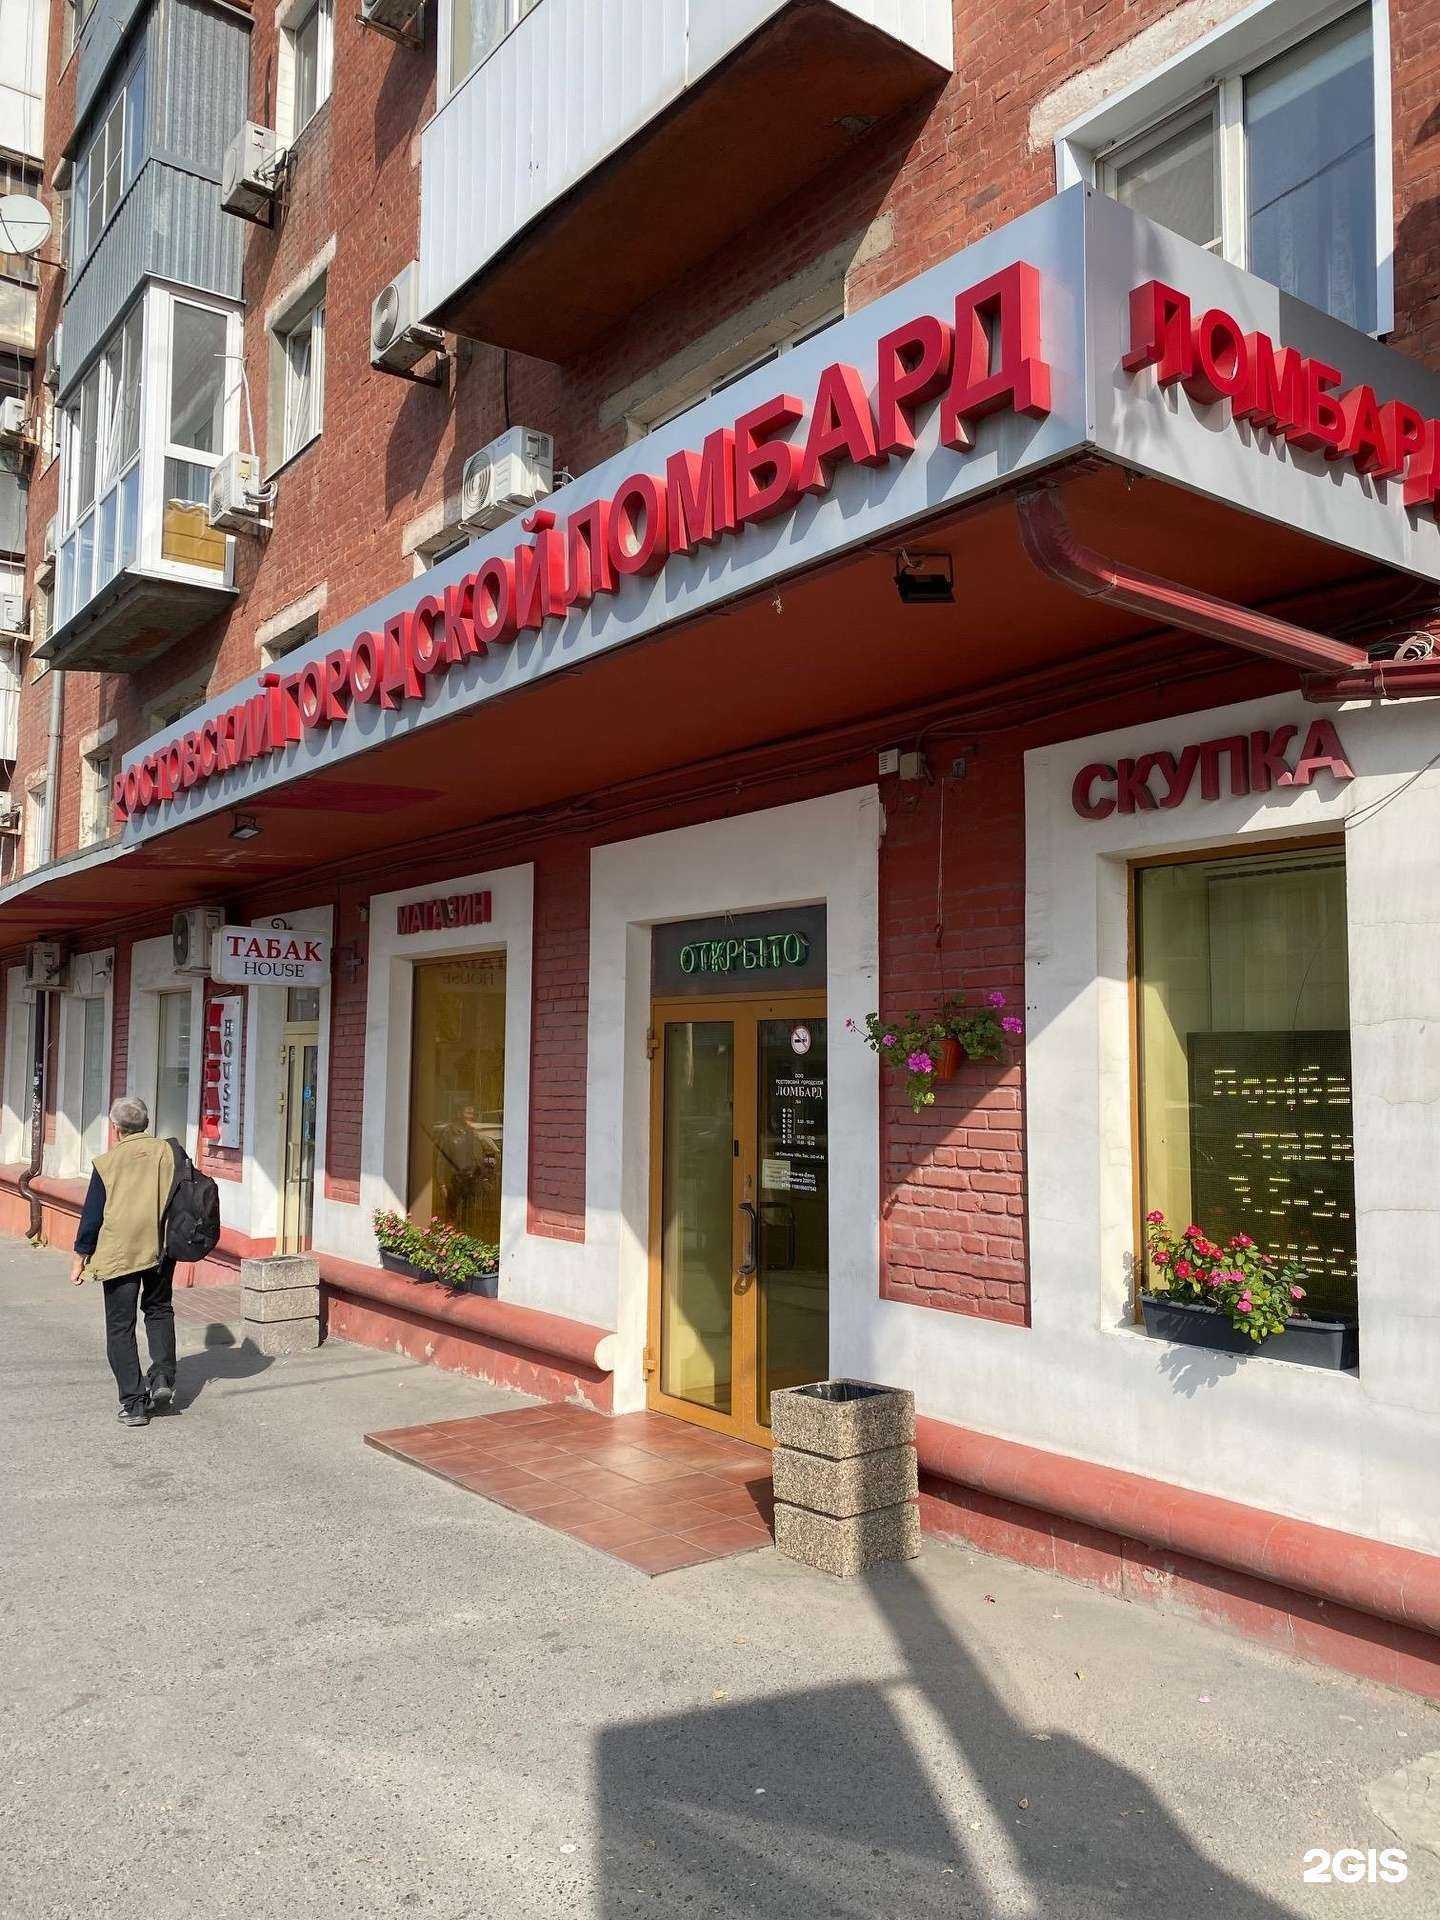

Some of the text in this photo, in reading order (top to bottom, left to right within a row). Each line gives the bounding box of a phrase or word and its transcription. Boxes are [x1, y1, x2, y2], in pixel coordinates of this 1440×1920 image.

[114, 260, 1051, 822] РОСТОВСКИЙ ГОРОДСКОЙ ЛОМБАРД
[1071, 718, 1356, 821] СКУПКА
[397, 890, 492, 935] МАГАЗИН
[226, 936, 323, 962] ТАБАК
[243, 961, 305, 978] HOUSE
[680, 932, 802, 974] ОТКРЫТО
[222, 1019, 234, 1124] HOUSE
[776, 1086, 823, 1099] ЛОМБАРД
